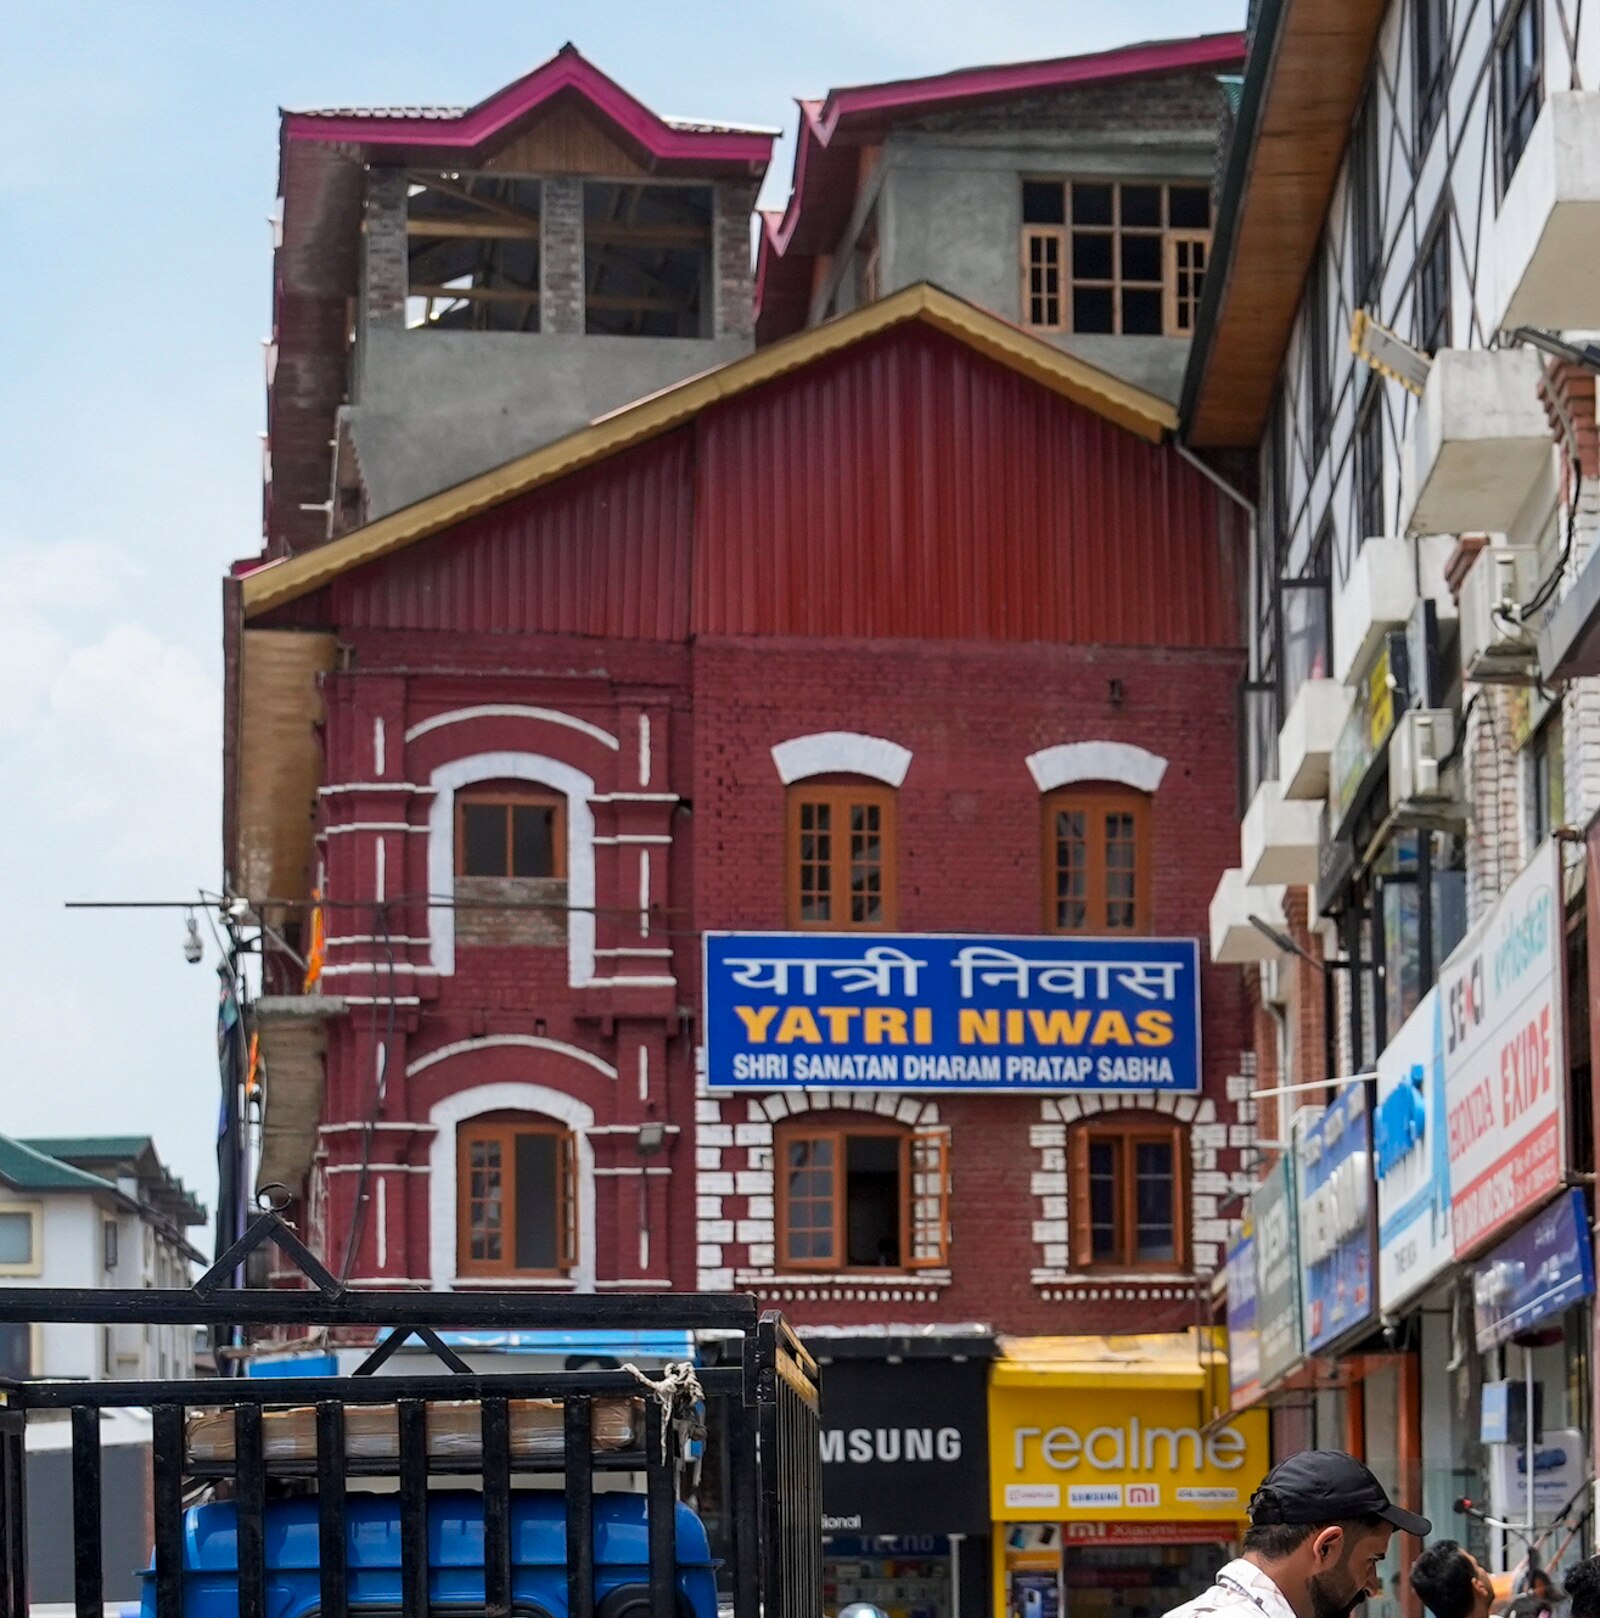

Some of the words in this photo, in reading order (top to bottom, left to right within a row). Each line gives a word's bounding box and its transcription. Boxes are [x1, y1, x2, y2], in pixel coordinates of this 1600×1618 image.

[723, 946, 928, 996] यात्री
[951, 946, 1184, 1001] निवास
[734, 1005, 933, 1045] YATRI
[958, 1007, 1175, 1047] NIWAS
[733, 1053, 789, 1081] SHRI
[793, 1053, 899, 1082] SANATAN
[903, 1053, 1000, 1083] DHARAM
[1005, 1054, 1092, 1083] PRATAP
[1096, 1055, 1175, 1084] SABHA
[1499, 1003, 1551, 1129] EXIDE
[819, 1427, 962, 1464] MSUNG
[1013, 1416, 1247, 1470] realme
[1070, 1491, 1120, 1503] SAMSUNG
